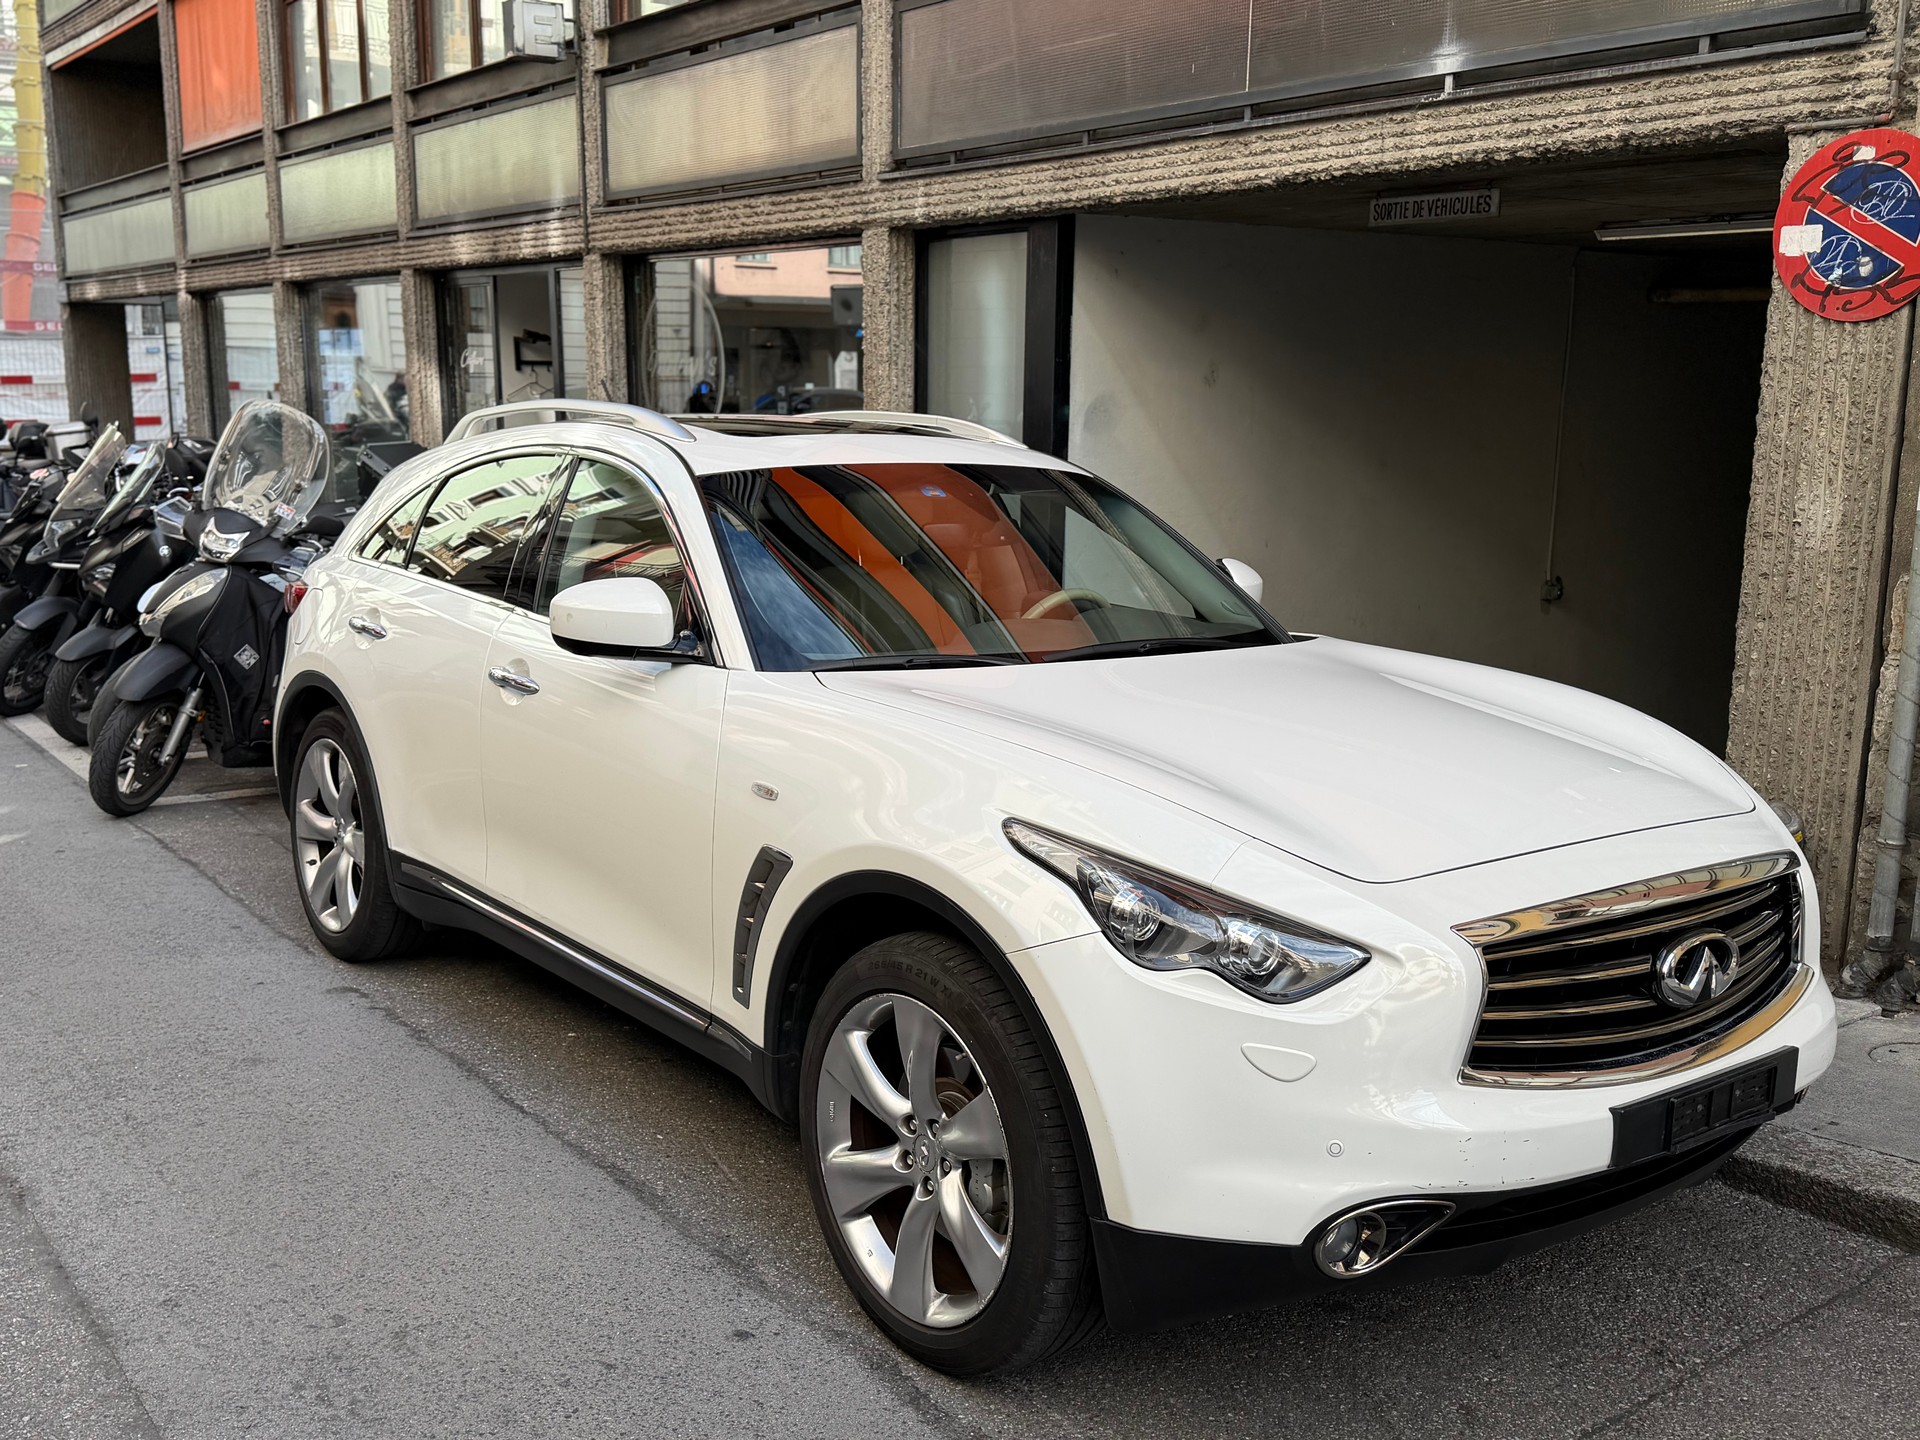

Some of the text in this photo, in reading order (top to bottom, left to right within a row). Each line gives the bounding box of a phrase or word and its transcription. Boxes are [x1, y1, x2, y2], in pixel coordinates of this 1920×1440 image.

[1373, 201, 1410, 222] SORTIE
[1412, 199, 1426, 218] DE
[914, 968, 928, 981] 21
